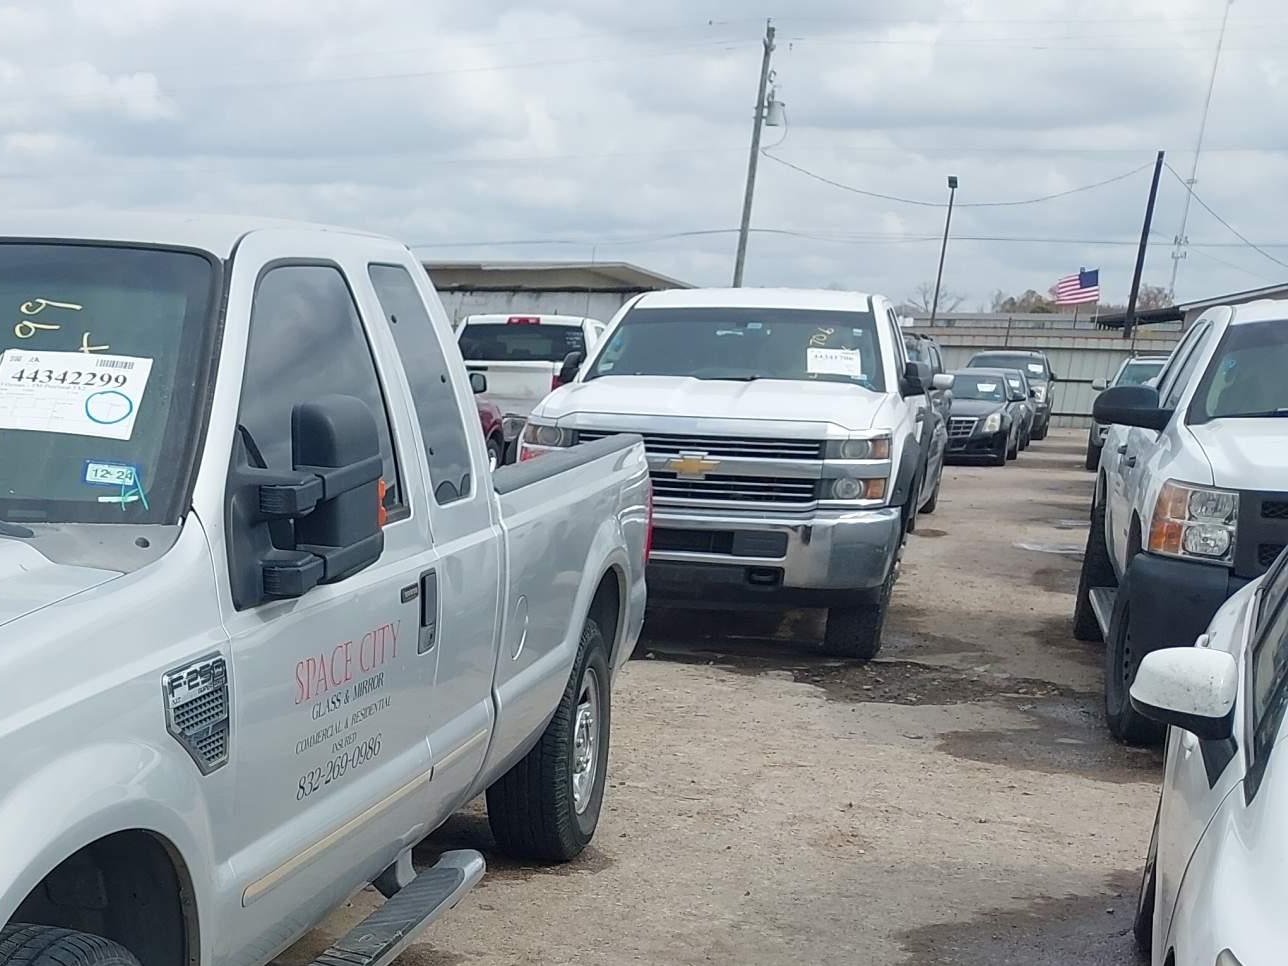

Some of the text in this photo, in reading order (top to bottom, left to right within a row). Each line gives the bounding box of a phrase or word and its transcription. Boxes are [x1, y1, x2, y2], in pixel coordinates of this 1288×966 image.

[11, 367, 128, 389] 44342299
[295, 620, 401, 705] SPACE CITY
[311, 672, 385, 721] GLASS & MIRROR
[295, 696, 392, 755] COMMERCIAL & RESIDENTIAL
[331, 732, 358, 754] INSURED
[296, 733, 383, 801] 832-269-0986
